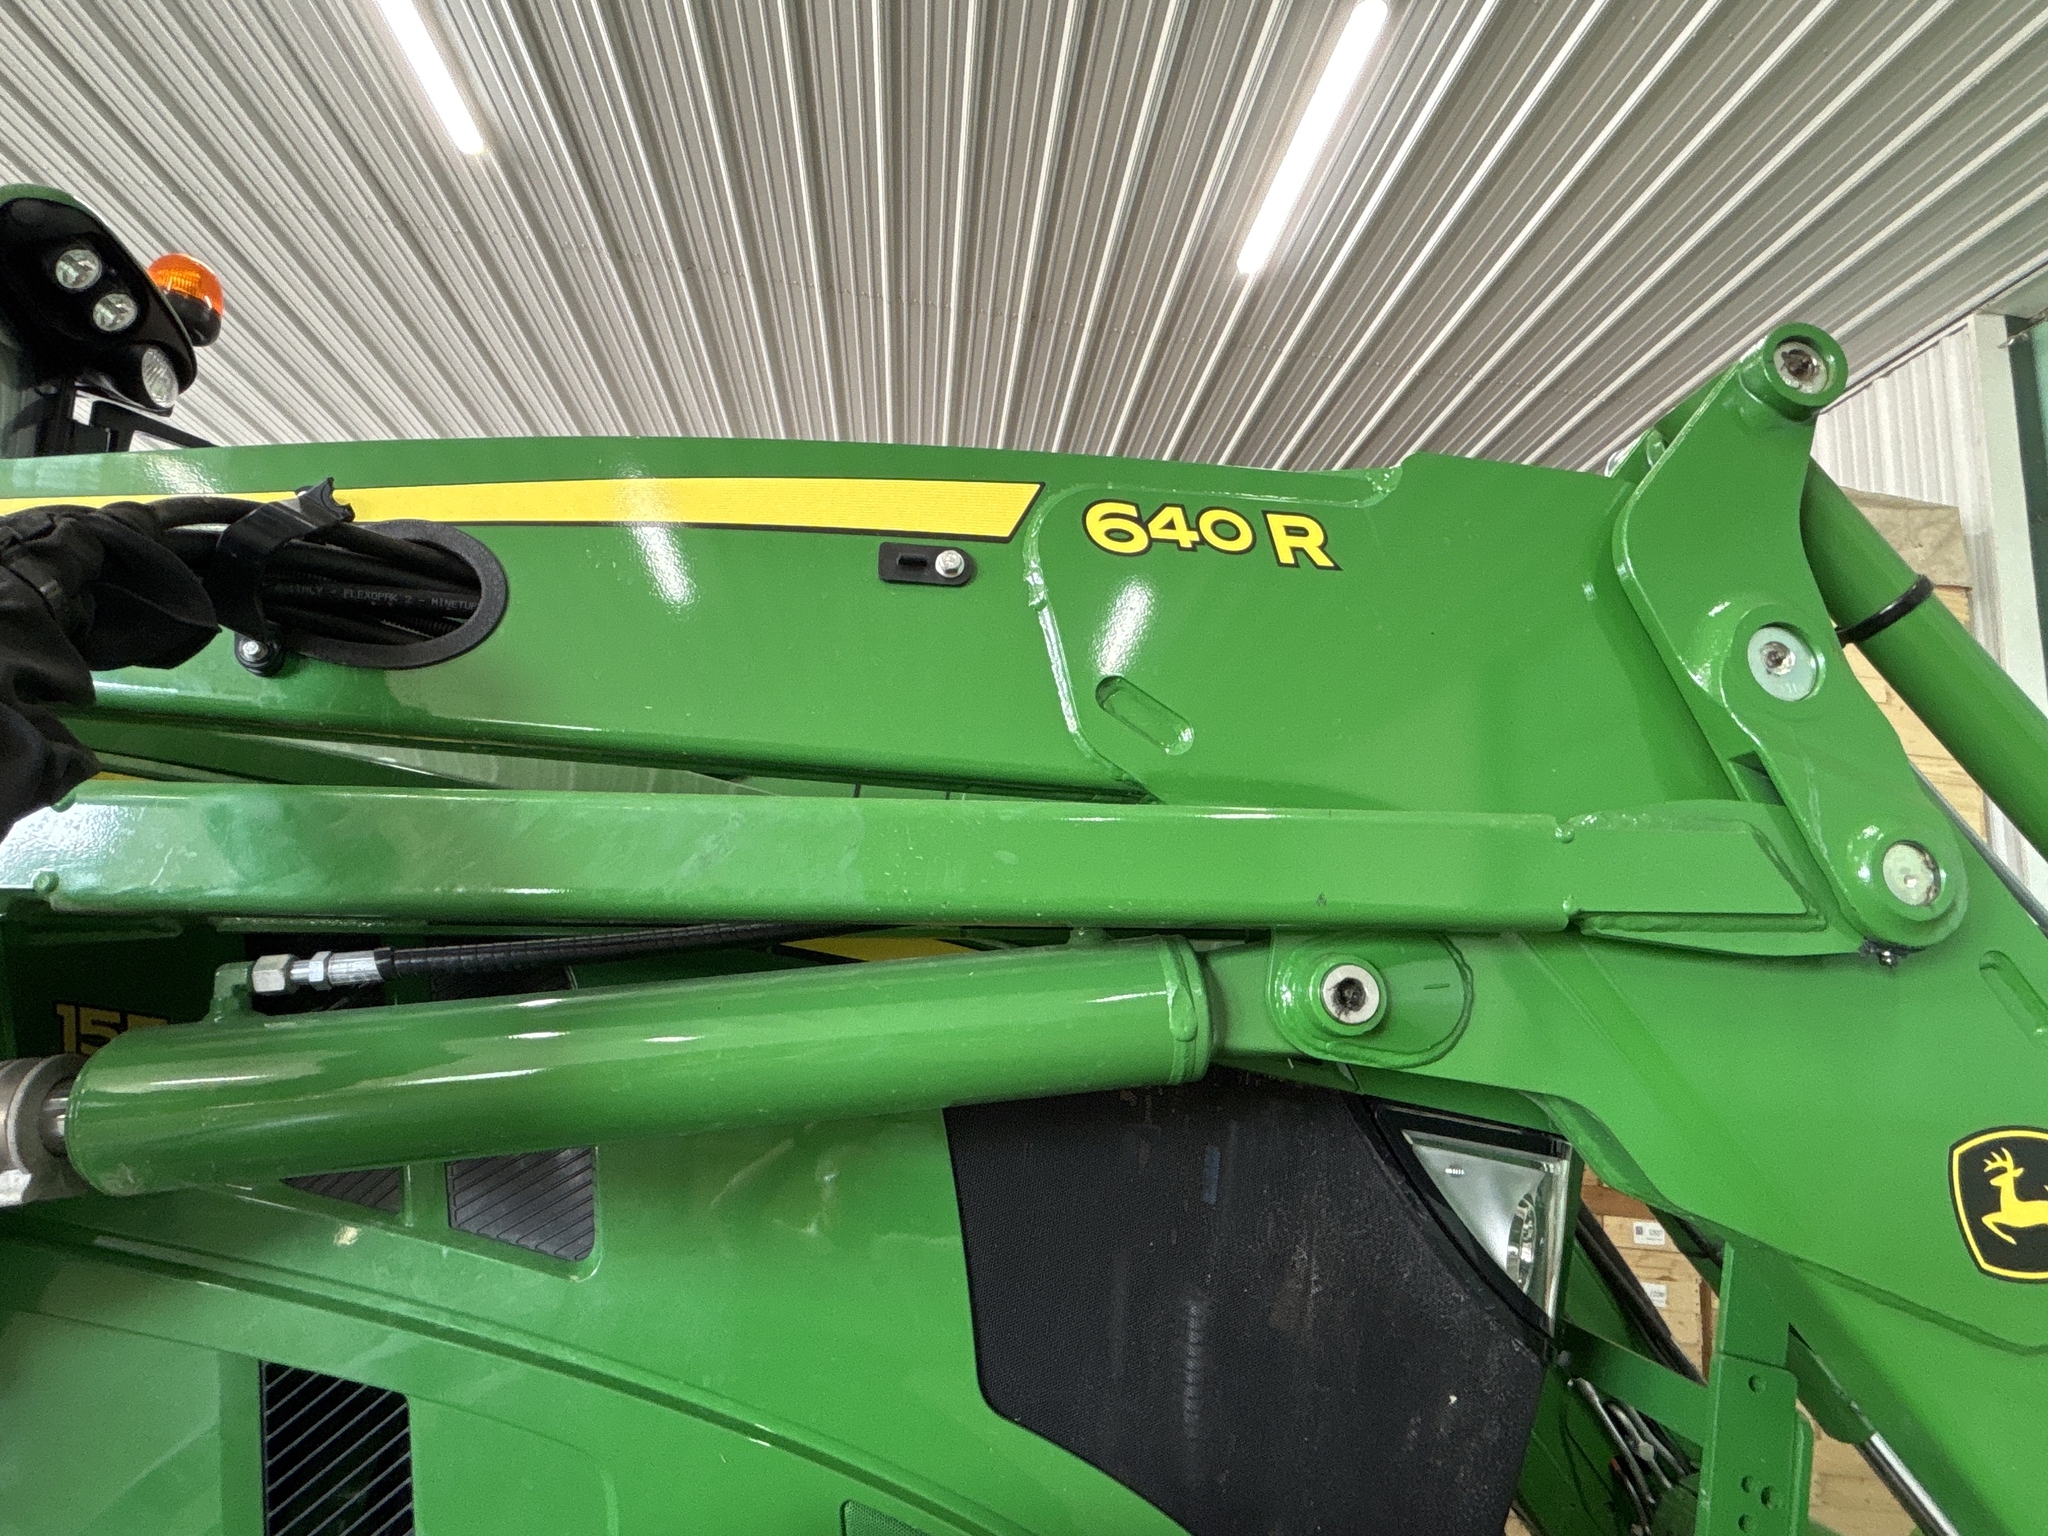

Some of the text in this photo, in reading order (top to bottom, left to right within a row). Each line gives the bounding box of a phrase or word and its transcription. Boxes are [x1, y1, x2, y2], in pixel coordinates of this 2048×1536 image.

[1083, 500, 1341, 570] 640 R
[55, 1003, 168, 1055] 15
